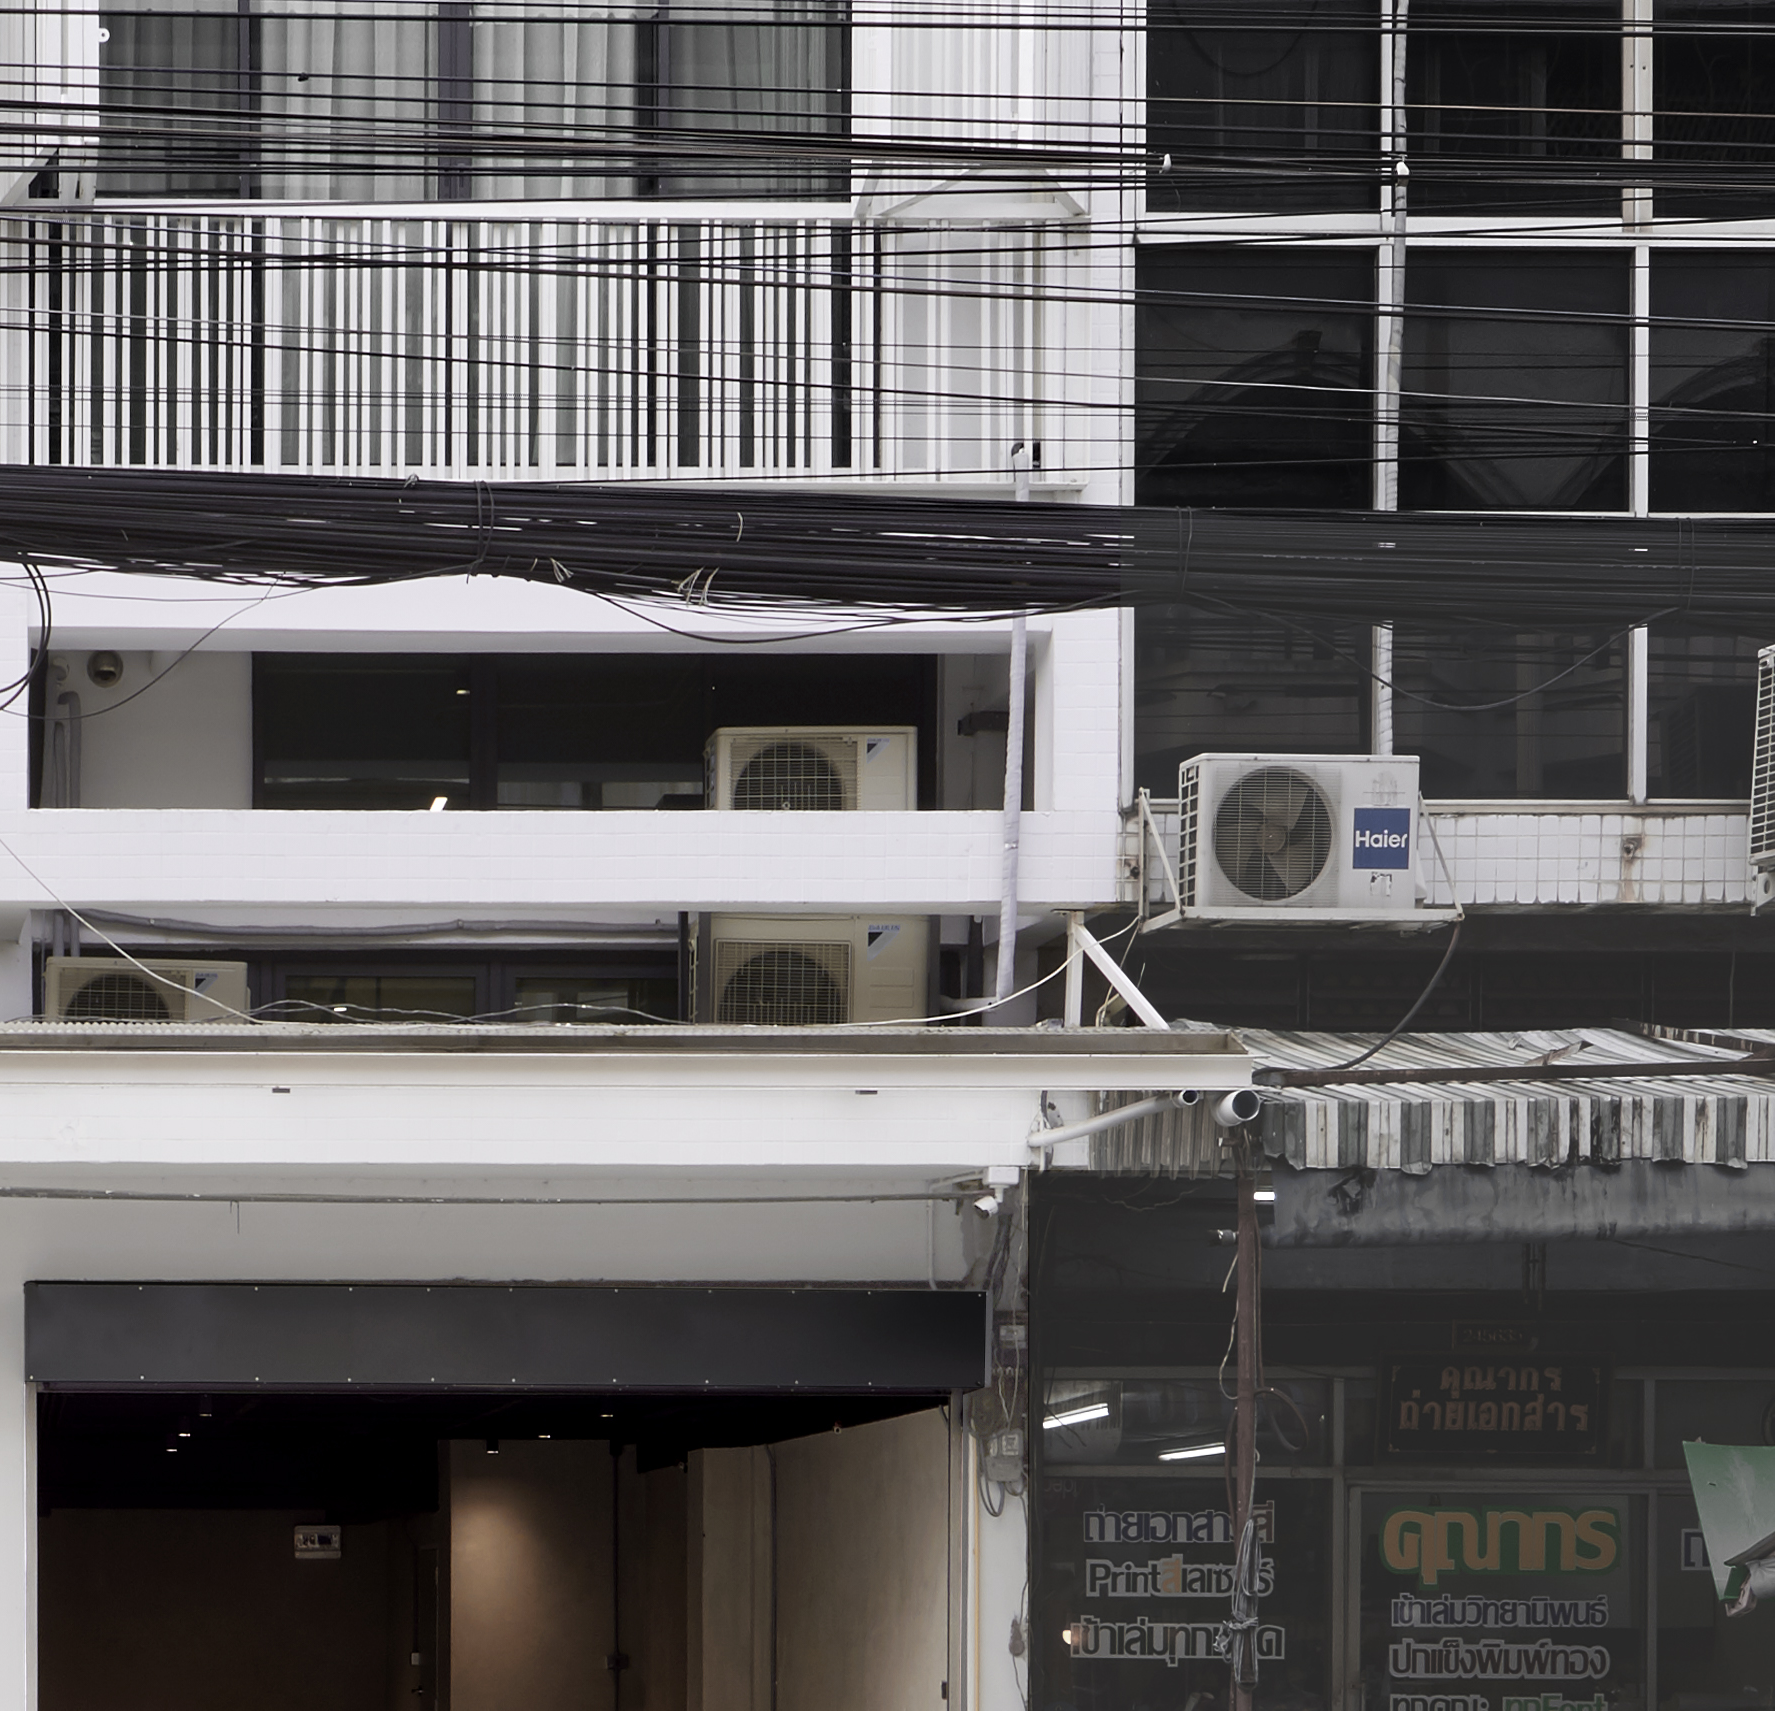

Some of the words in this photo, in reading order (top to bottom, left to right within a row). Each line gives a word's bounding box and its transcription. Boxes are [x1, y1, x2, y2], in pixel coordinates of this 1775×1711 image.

[1355, 829, 1408, 848] Haier
[1439, 1366, 1563, 1399] คุณากร
[1399, 1389, 1589, 1431] ถ่ายเอกสาร
[1083, 1500, 1275, 1543] ถ่ายเอกสาสี
[1382, 1510, 1618, 1585] คุณากร
[1392, 1592, 1609, 1628] เข้าเล่มวิทยานิพนธ์
[1389, 1638, 1611, 1679] ปกแข็งพิมพ์ทอง
